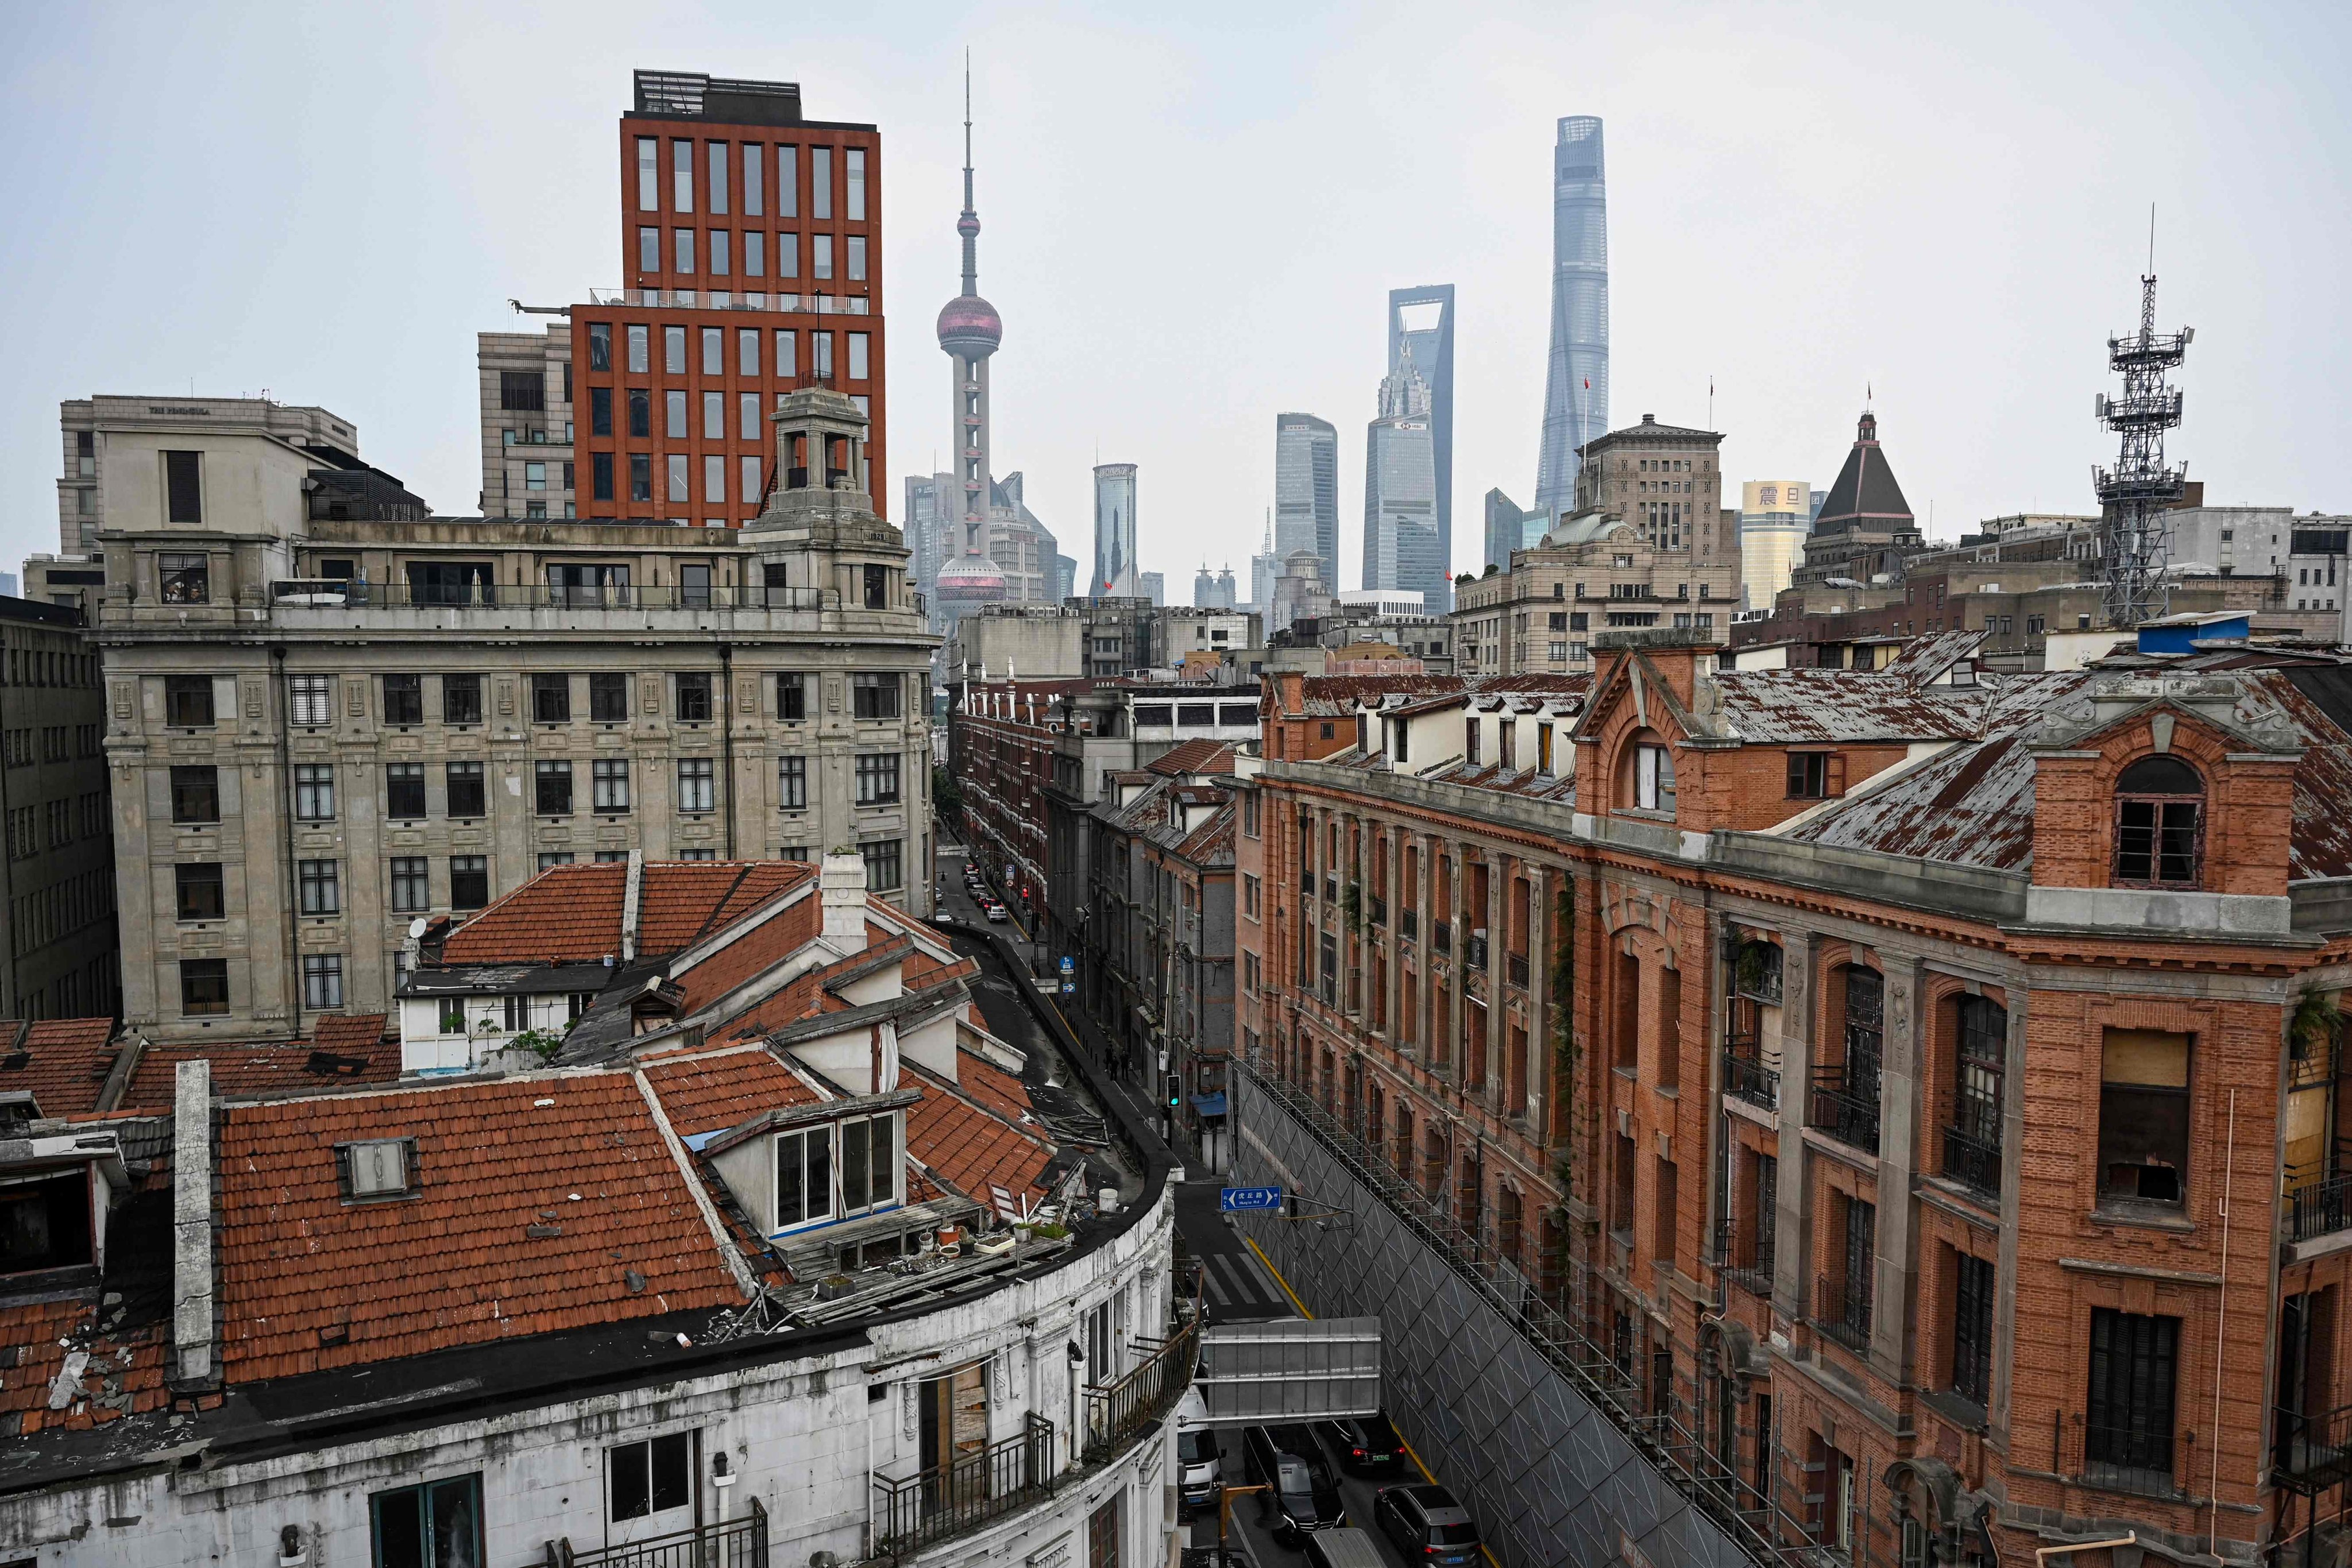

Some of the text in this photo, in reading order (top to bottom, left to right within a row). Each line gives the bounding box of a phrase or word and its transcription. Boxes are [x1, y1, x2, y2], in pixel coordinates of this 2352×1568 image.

[1759, 486, 1800, 505] 震旦
[1811, 495, 1820, 505] 团
[871, 532, 885, 540] 1929
